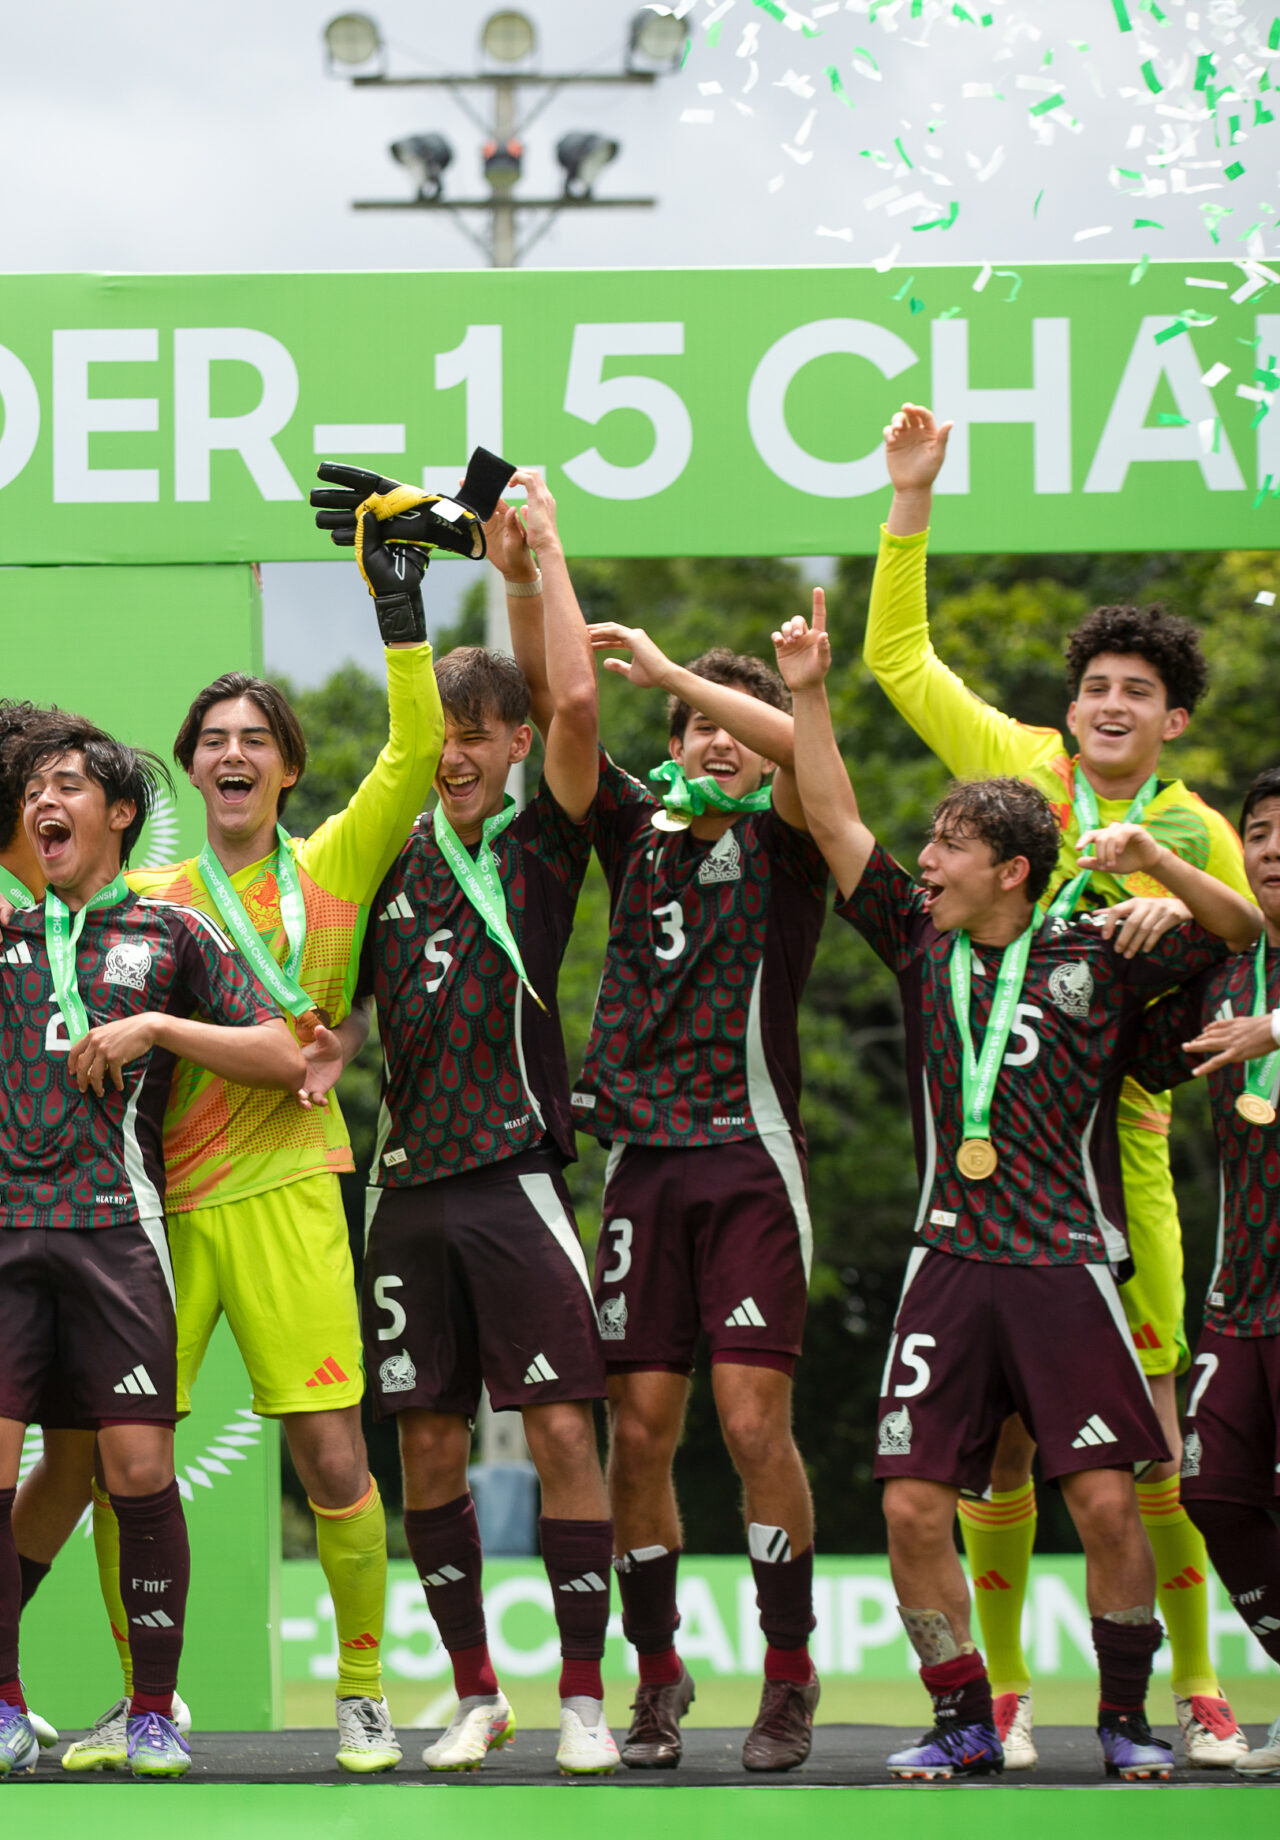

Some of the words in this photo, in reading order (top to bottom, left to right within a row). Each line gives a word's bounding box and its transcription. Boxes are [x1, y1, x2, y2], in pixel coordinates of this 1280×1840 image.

[227, 904, 254, 949] UNDER-15
[250, 946, 297, 1003] CHAMPIONSHIP
[424, 928, 454, 994] 5
[651, 900, 687, 961] 3
[603, 1218, 633, 1283] 3
[373, 1274, 408, 1341] 5
[880, 1332, 937, 1398] 15
[1185, 1352, 1220, 1417] 7
[132, 1578, 173, 1595] FMF
